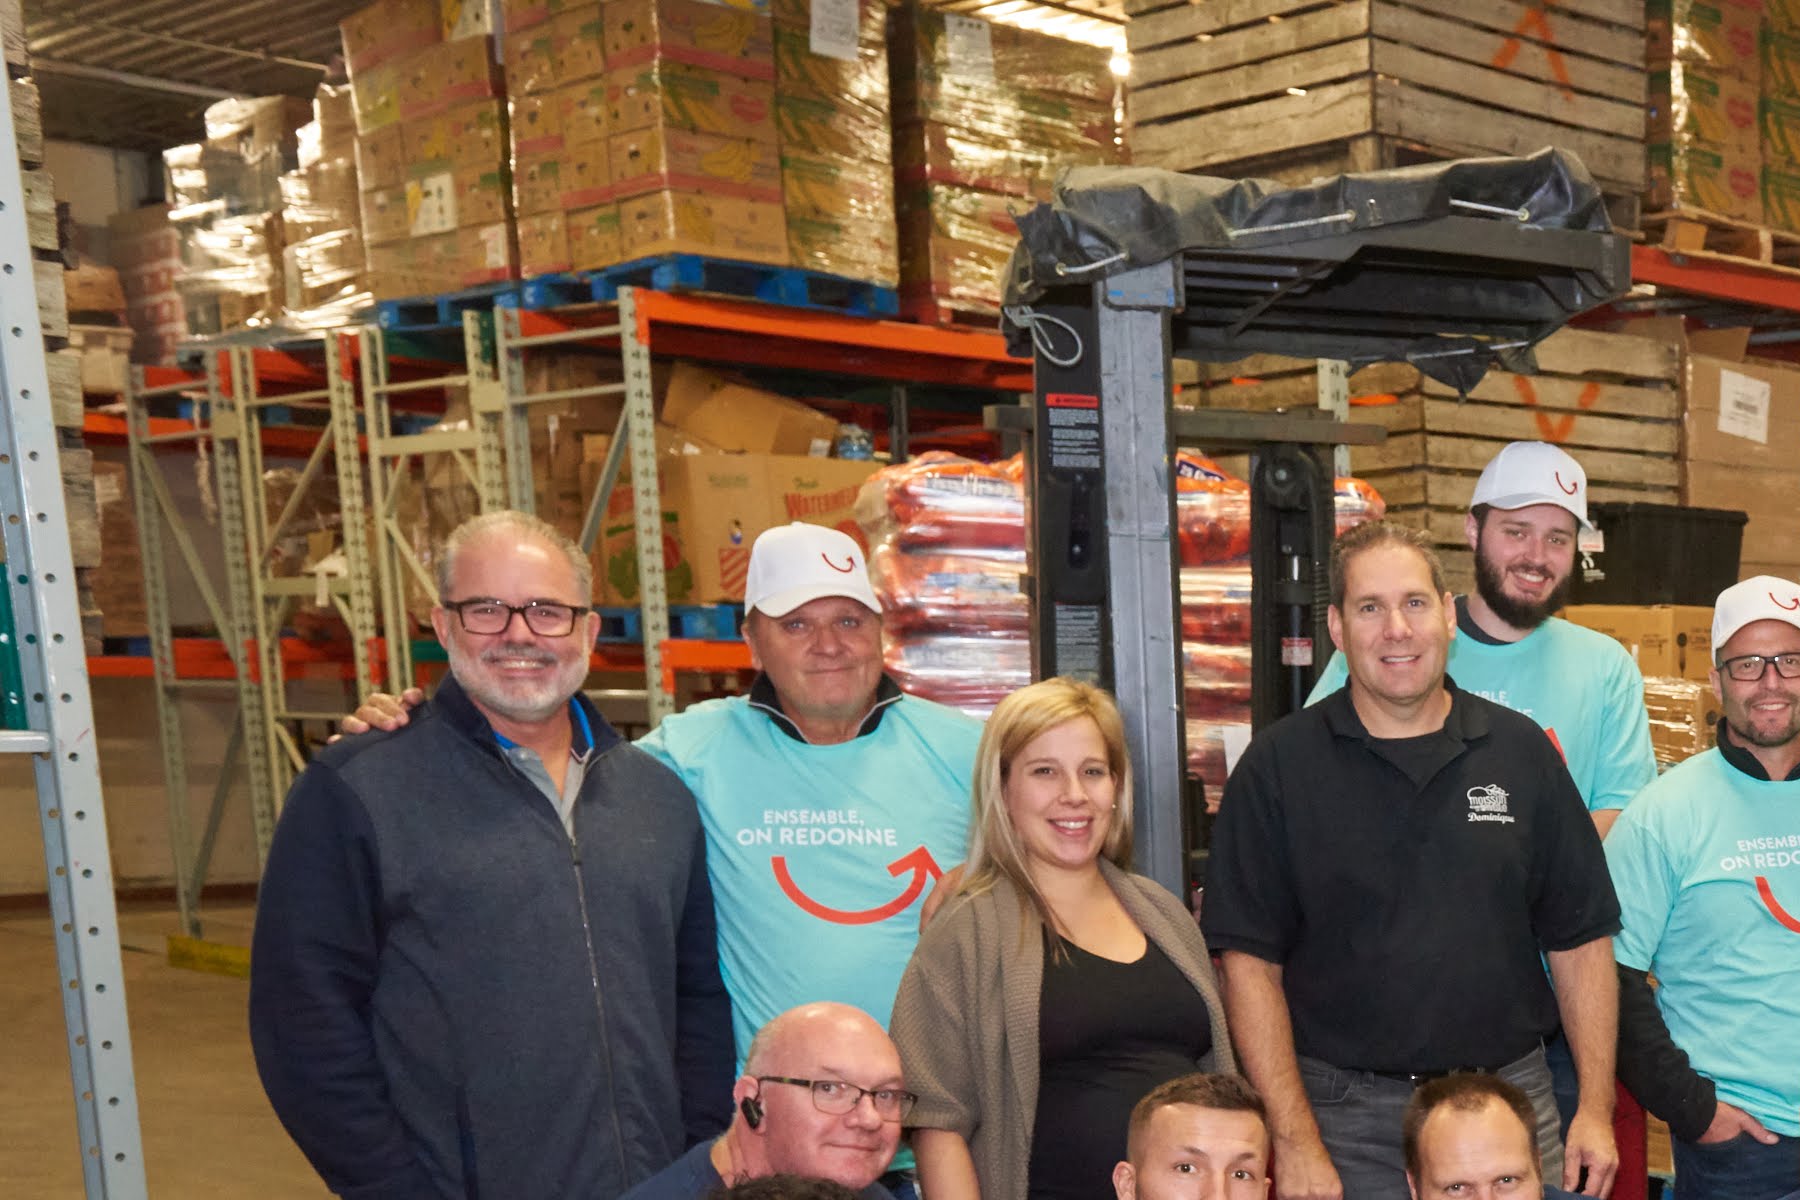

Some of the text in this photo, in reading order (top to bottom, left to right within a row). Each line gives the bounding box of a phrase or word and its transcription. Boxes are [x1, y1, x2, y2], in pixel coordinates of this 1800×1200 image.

[737, 828, 897, 846] ON REDONNE
[1720, 852, 1751, 872] ON
